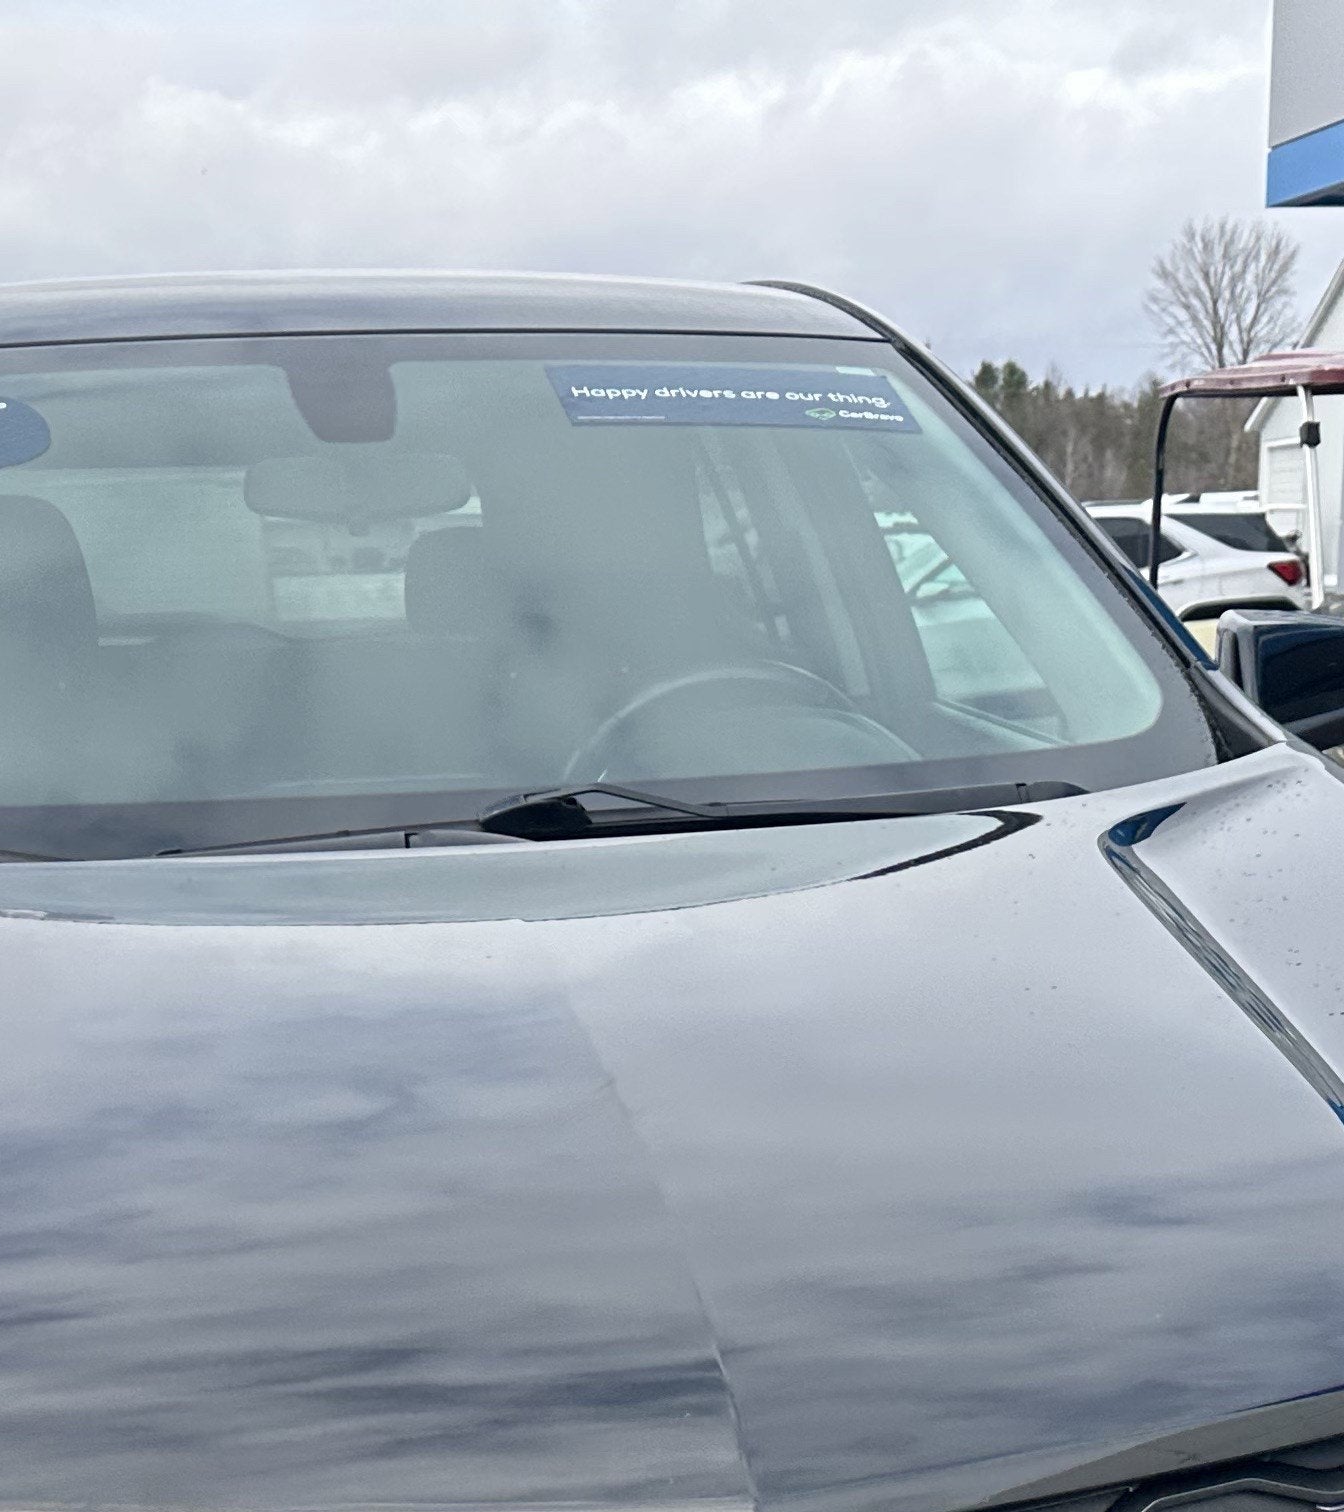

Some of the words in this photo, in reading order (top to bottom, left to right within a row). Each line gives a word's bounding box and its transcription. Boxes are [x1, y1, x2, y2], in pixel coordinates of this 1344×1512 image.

[571, 386, 648, 400] Happy
[654, 387, 736, 399] drivers
[740, 390, 780, 400] are
[785, 391, 822, 401] our
[827, 392, 891, 409] thing.
